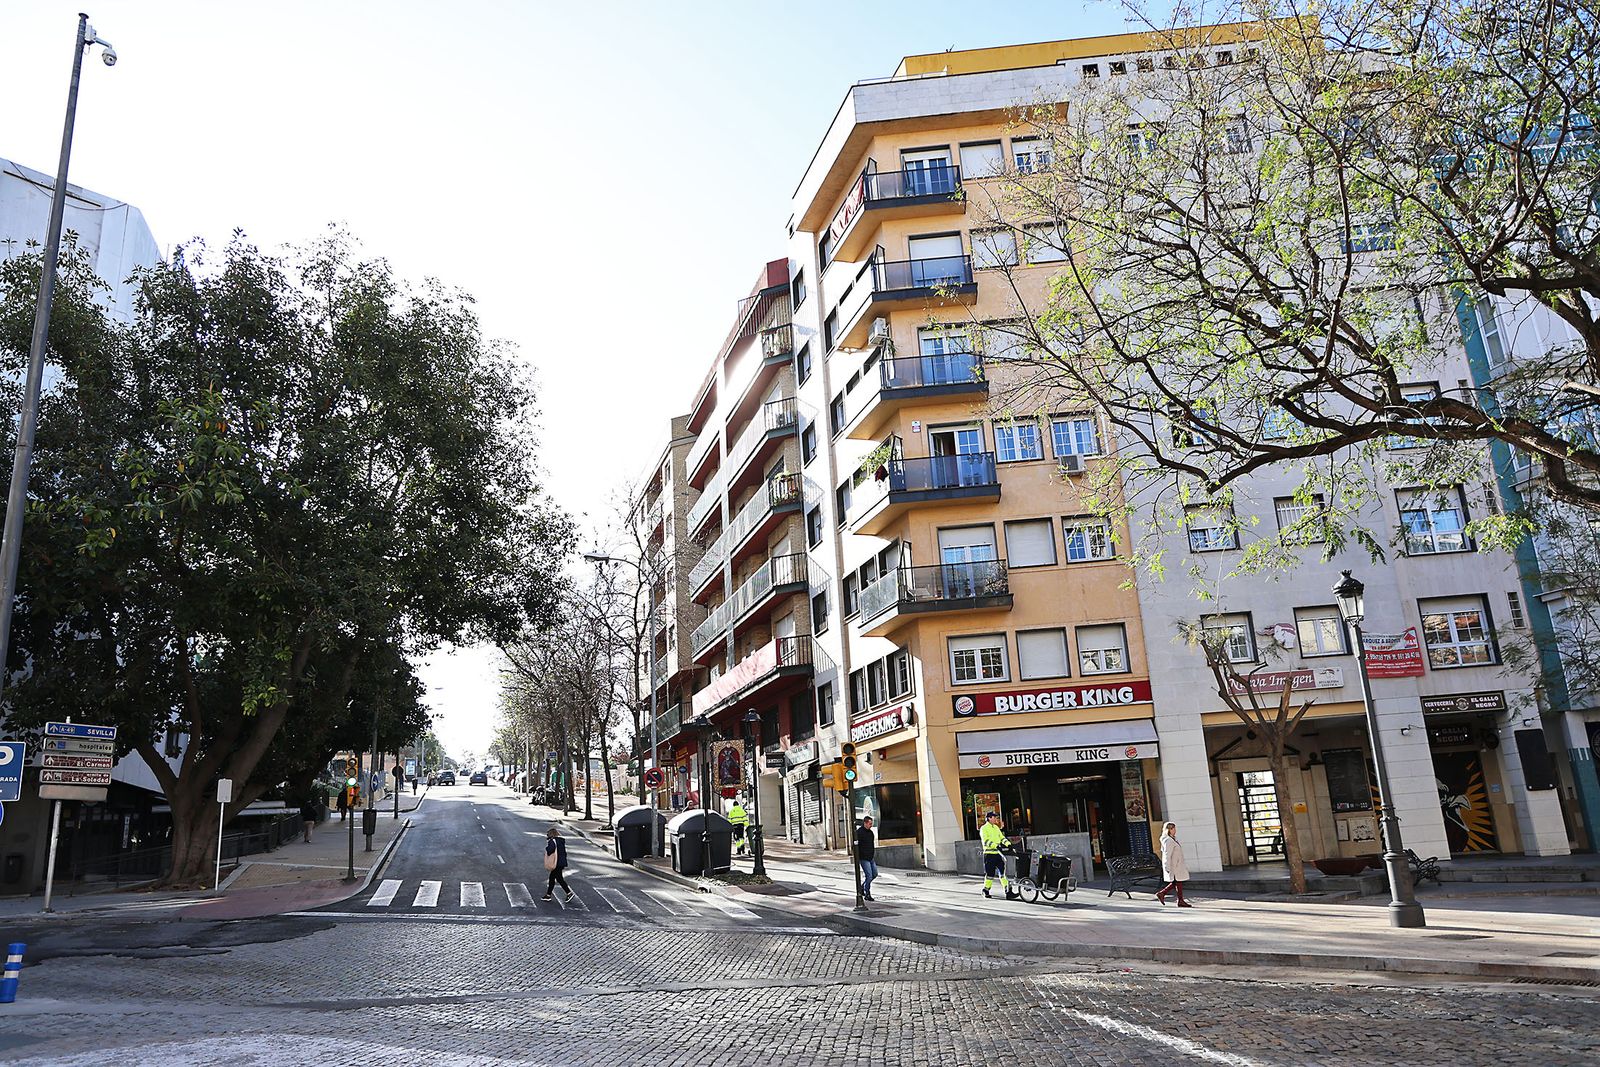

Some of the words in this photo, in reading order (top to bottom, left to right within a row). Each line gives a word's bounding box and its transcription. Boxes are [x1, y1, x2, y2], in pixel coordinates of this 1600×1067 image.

[1228, 678, 1267, 691] Nva
[1269, 674, 1314, 689] Imgen
[995, 692, 1077, 714] BURGER
[1081, 686, 1134, 706] KING
[1479, 695, 1499, 703] GALLO
[87, 728, 113, 736] SEVILLA
[851, 718, 879, 742] BURGER
[877, 712, 898, 732] KING
[1005, 752, 1060, 765] BURGER
[1075, 748, 1110, 761] KING
